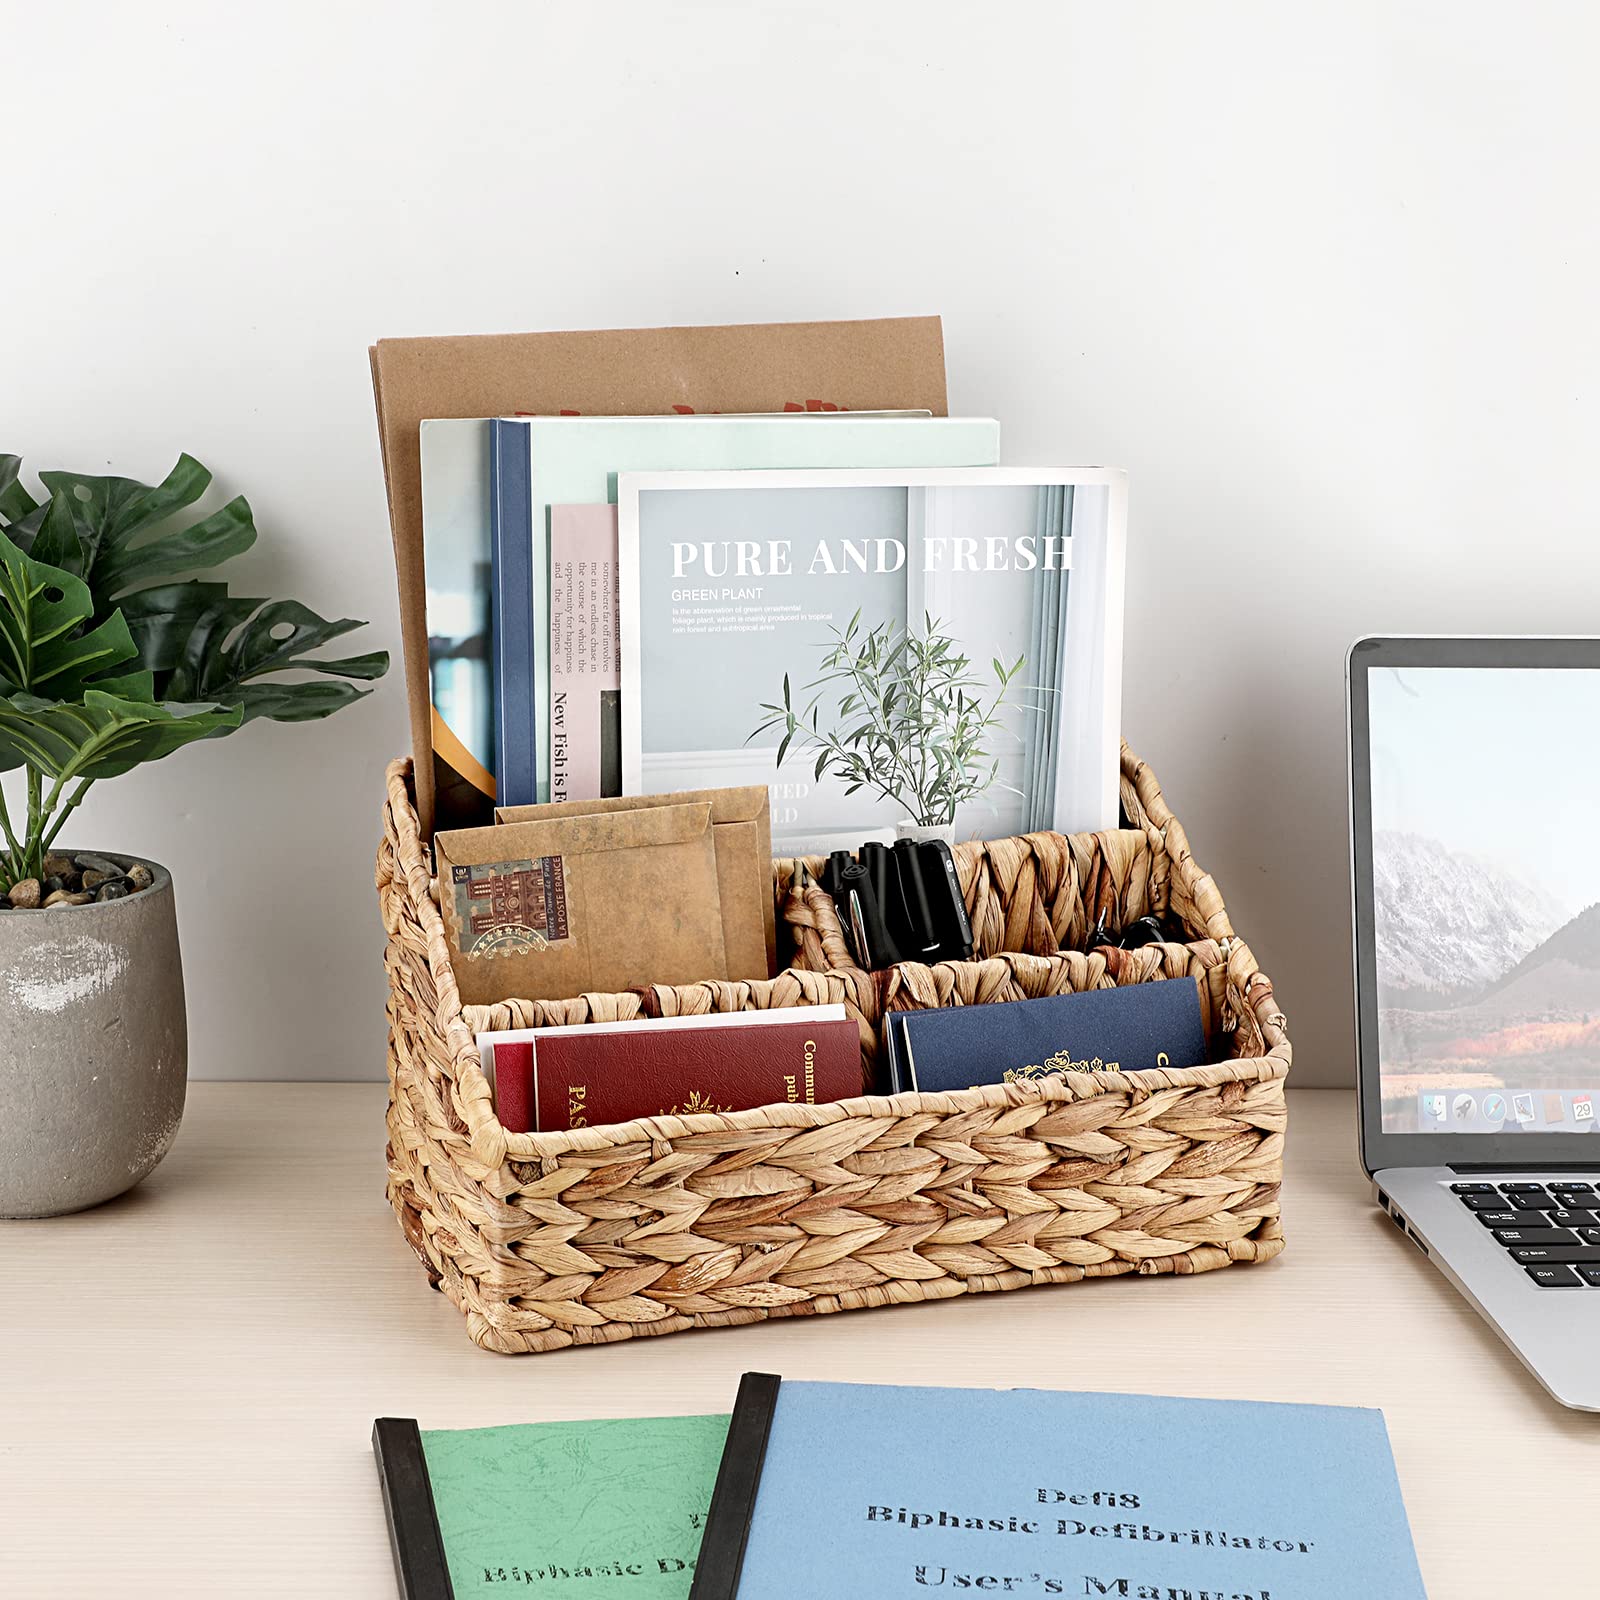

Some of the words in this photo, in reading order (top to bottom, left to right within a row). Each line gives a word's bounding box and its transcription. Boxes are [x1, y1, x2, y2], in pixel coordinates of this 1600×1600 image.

[671, 540, 792, 578] PURE
[808, 538, 906, 575] AND
[922, 535, 1075, 572] FRESH
[555, 562, 563, 578] and
[579, 562, 587, 575] the
[591, 562, 597, 575] me
[565, 562, 574, 614] opportunity
[591, 578, 598, 587] in
[603, 562, 611, 610] somewhere
[555, 589, 563, 602] the
[591, 590, 597, 601] an
[671, 589, 718, 601] GREEN
[722, 588, 763, 600] PLANT
[567, 616, 575, 628] for
[579, 614, 587, 624] of
[591, 604, 599, 635] endless
[603, 612, 611, 623] far
[767, 614, 800, 623] produced
[808, 612, 832, 621] tropical
[552, 612, 563, 655] happiness
[603, 624, 611, 638] off
[708, 625, 721, 633] and
[579, 628, 587, 654] which
[565, 631, 575, 673] happiness
[591, 638, 599, 661] chase
[603, 638, 611, 673] involves
[555, 664, 563, 675] of
[579, 660, 587, 673] the
[591, 664, 598, 673] in
[554, 692, 567, 728] New
[554, 733, 568, 768] Fish
[554, 773, 568, 786] is
[552, 857, 564, 893] FRANCE
[547, 891, 555, 915] Dame
[556, 895, 566, 923] POSTE
[548, 917, 556, 939] Notre
[559, 925, 567, 937] LA
[1576, 1103, 1591, 1117] 29
[1034, 1487, 1142, 1509] Defi8
[865, 1505, 1041, 1535] Biphasic
[1056, 1519, 1316, 1555] Defibrillator
